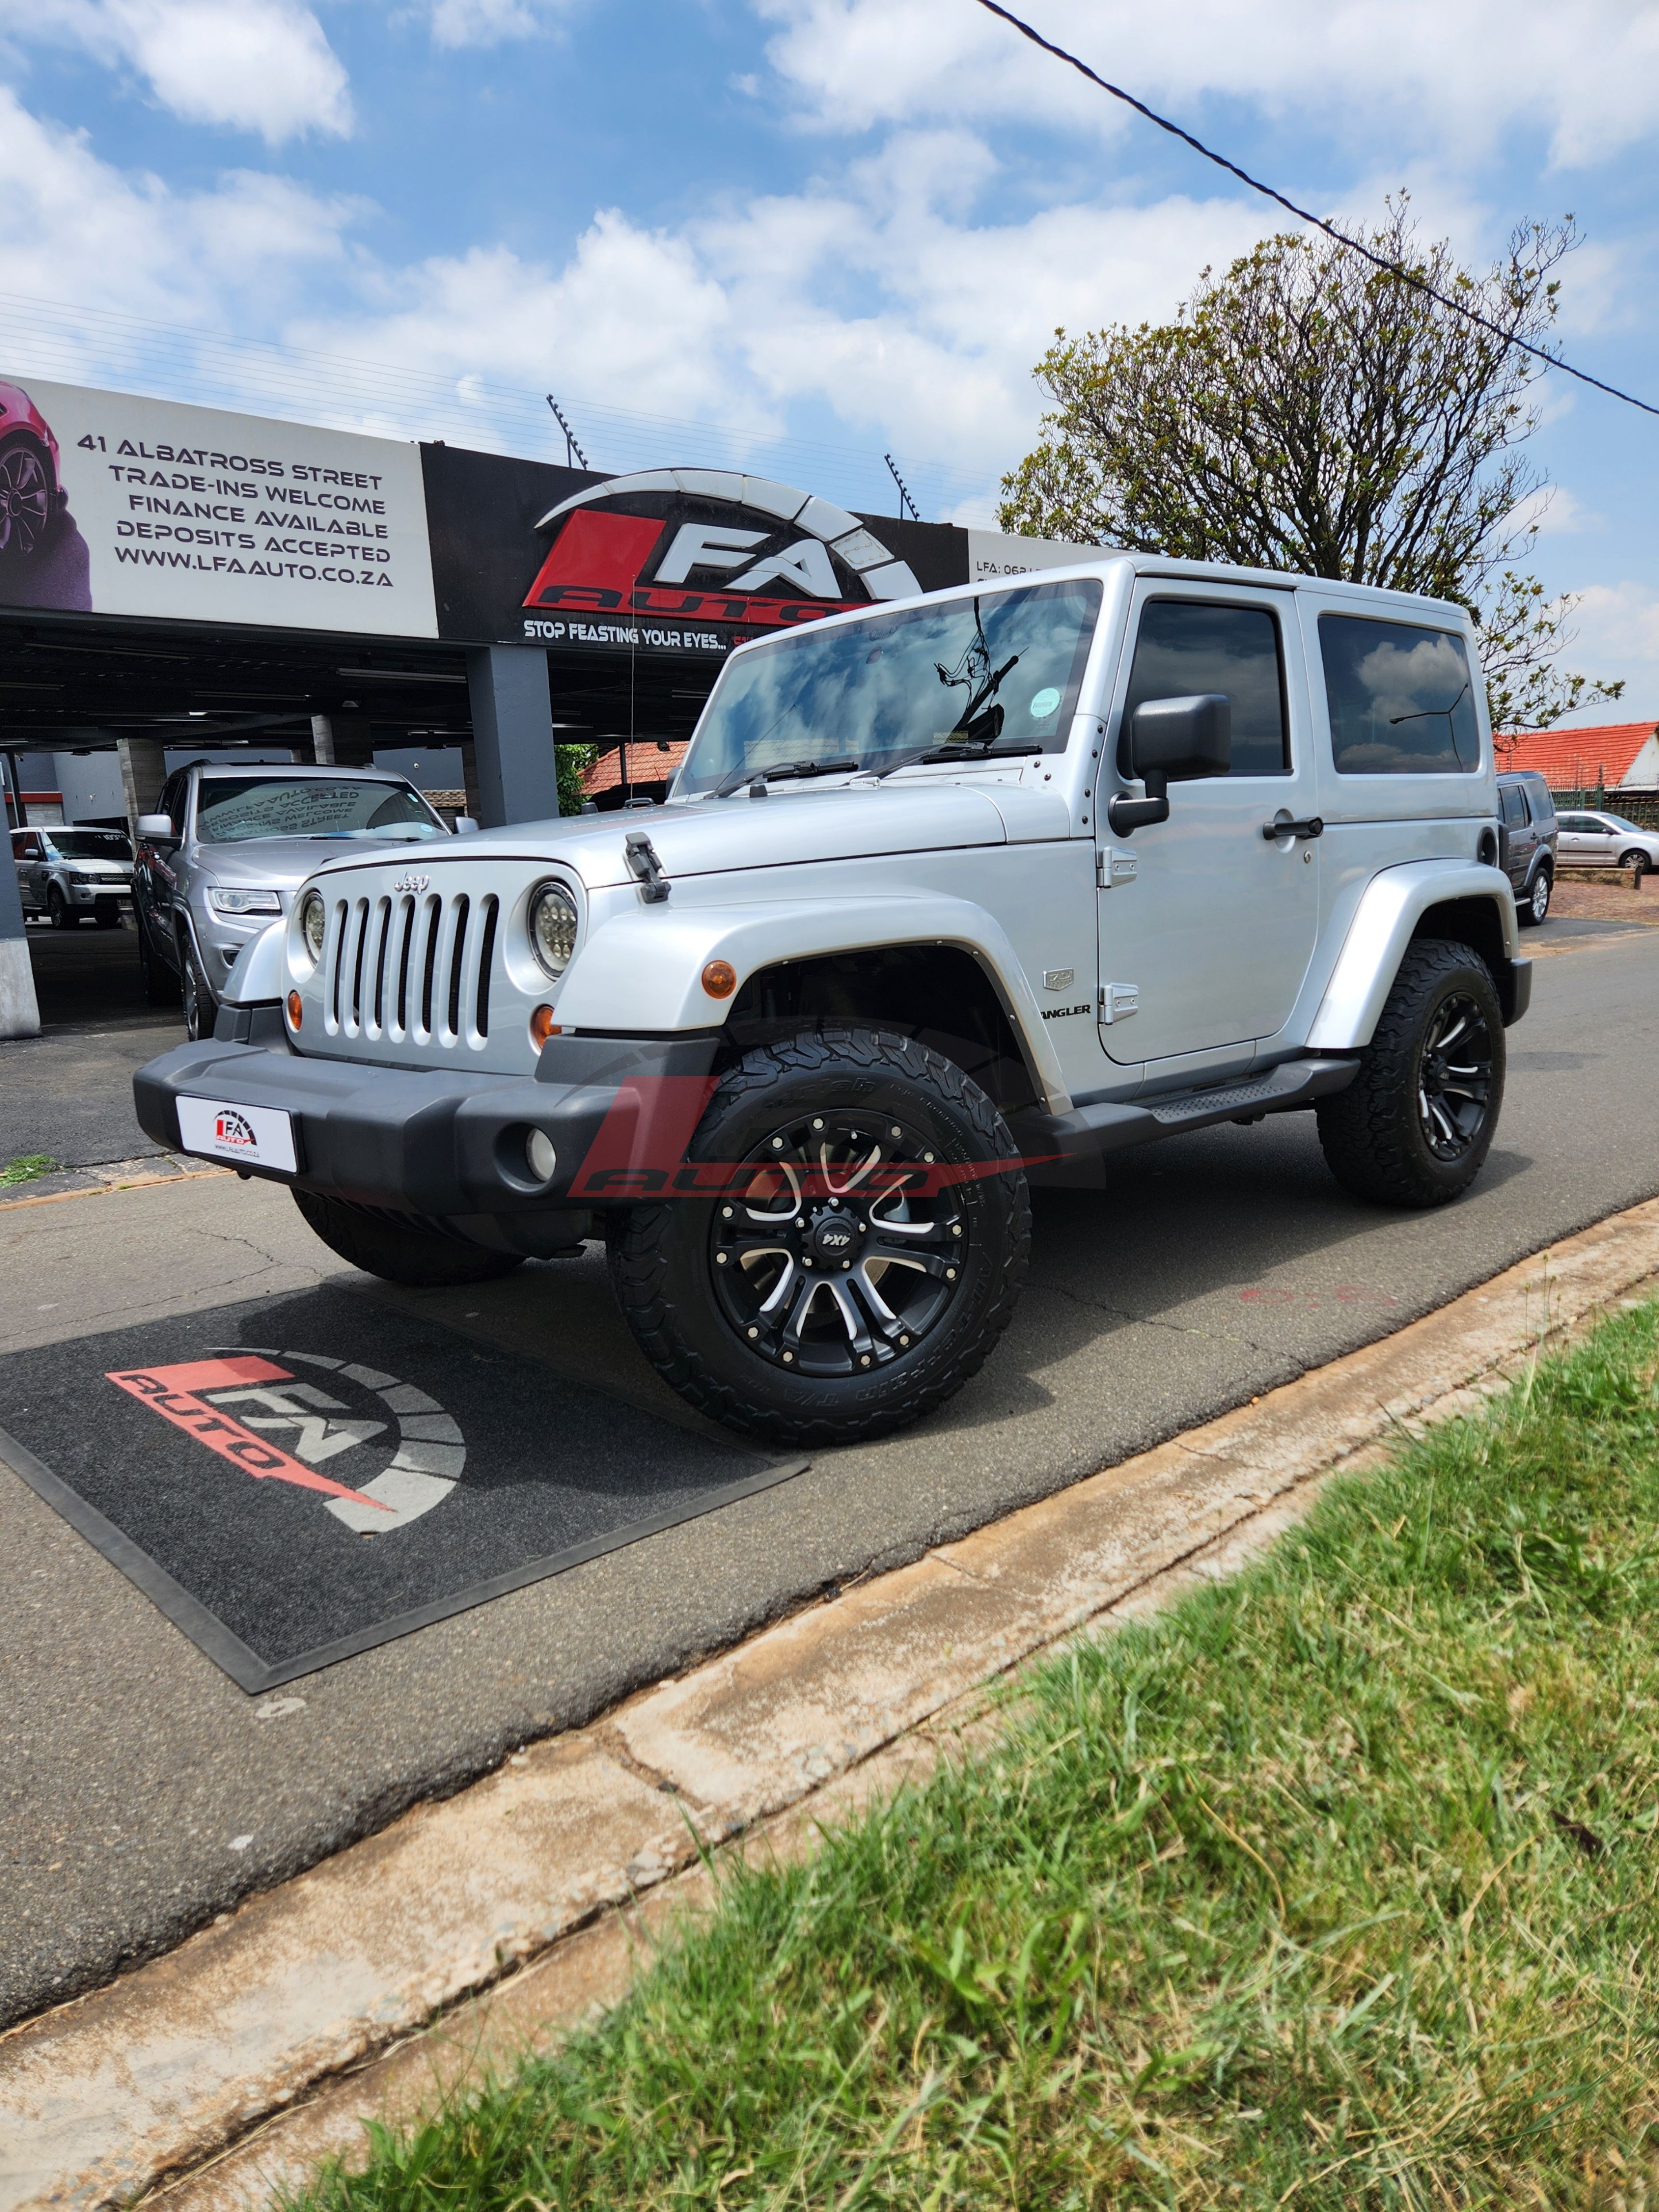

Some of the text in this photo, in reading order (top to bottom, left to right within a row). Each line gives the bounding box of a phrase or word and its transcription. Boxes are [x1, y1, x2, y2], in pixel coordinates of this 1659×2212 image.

[77, 434, 383, 490] 41 ALBATROSS STREET
[108, 465, 386, 515] TRADE-INS WELCOME
[129, 494, 389, 539] FINANCE AVAILABLE
[117, 520, 390, 563] DEPOSITS ACCEPTED
[114, 546, 394, 587] WWW.LFAAUTO.CO.ZA
[976, 561, 1001, 574] LFA:
[538, 585, 841, 621] AUTO
[524, 620, 565, 639] STOP
[569, 623, 639, 644] FEASTING
[641, 628, 681, 647] YOUR
[684, 632, 727, 650] EYES...
[394, 871, 430, 895] Jeep
[1040, 1004, 1091, 1019] ANGLER
[119, 1374, 285, 1470] AUTO
